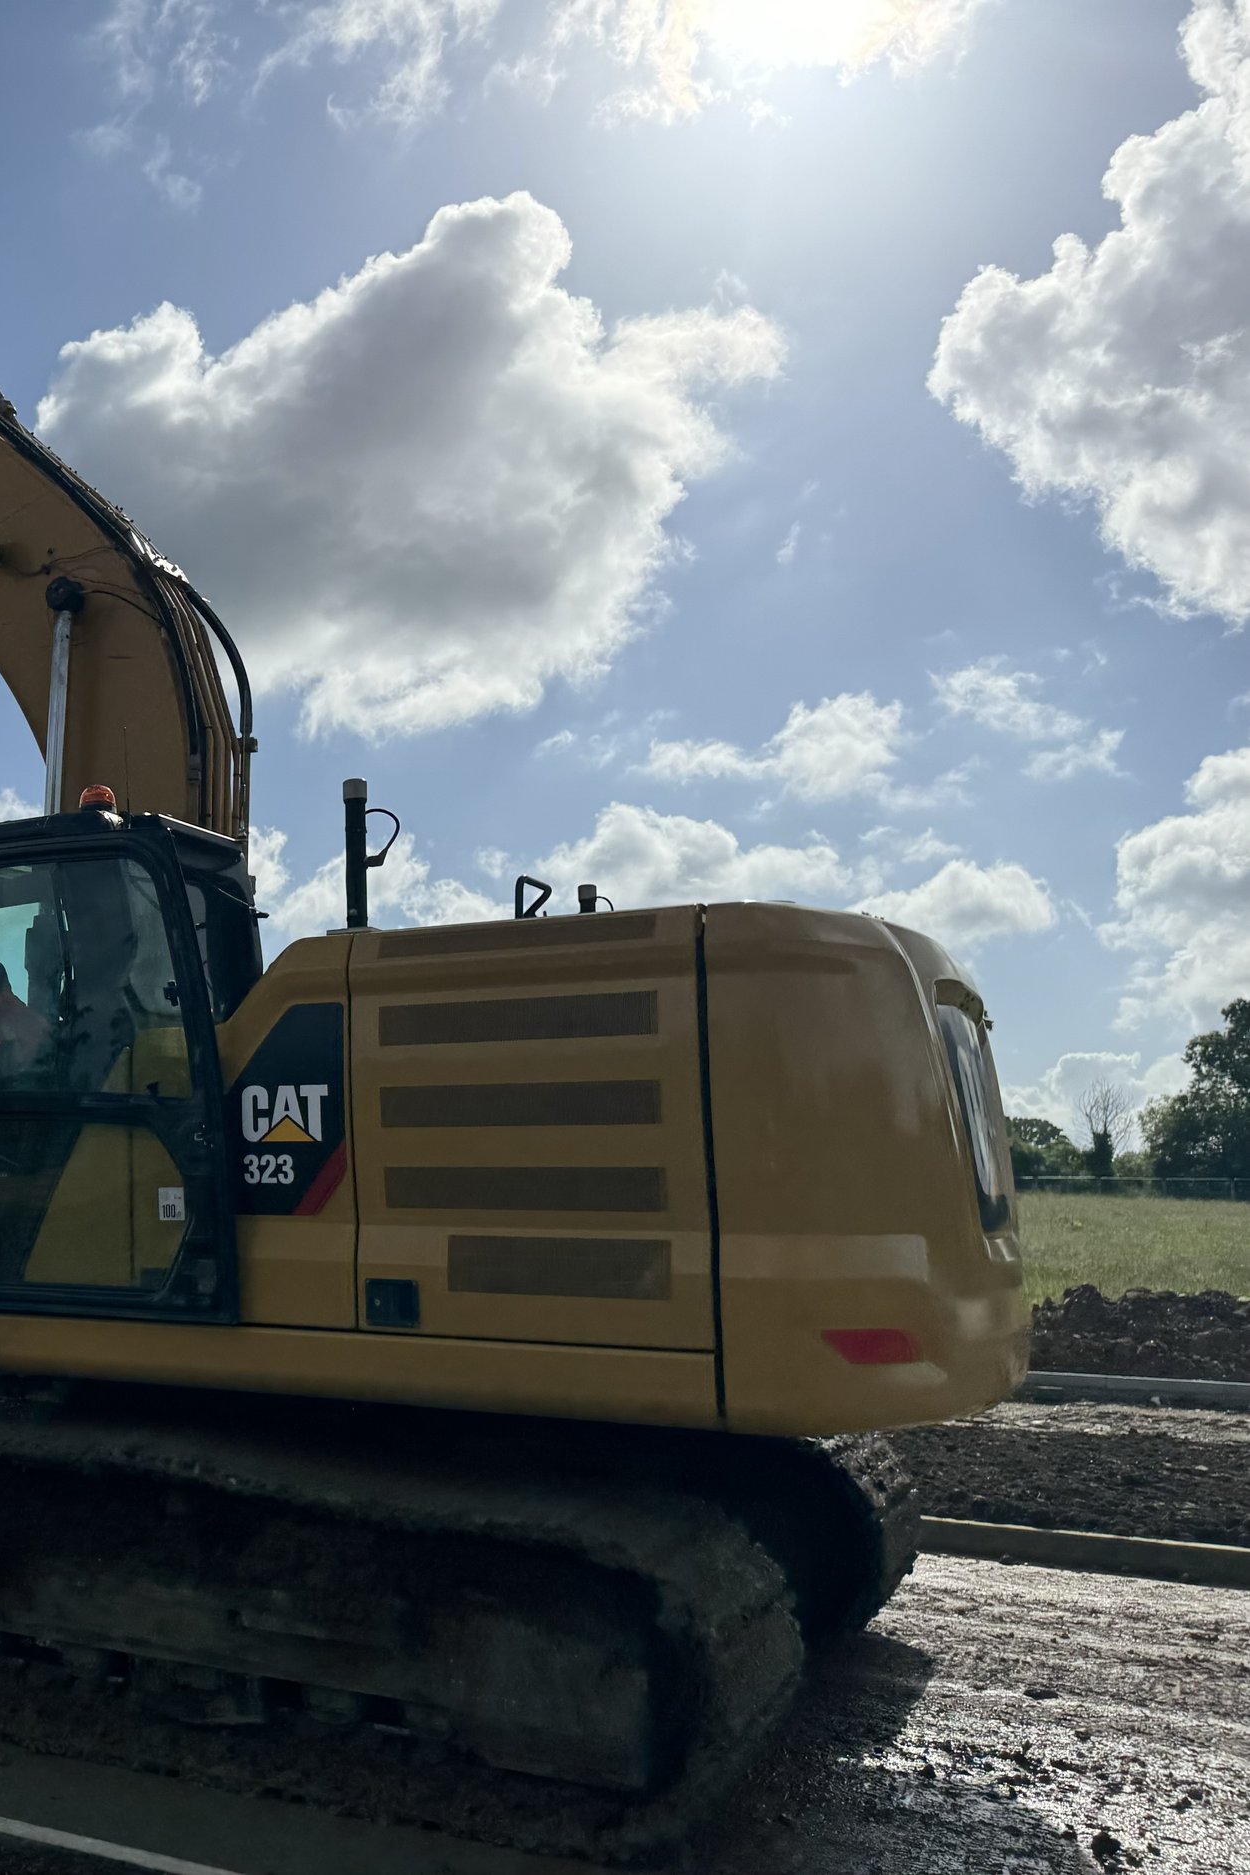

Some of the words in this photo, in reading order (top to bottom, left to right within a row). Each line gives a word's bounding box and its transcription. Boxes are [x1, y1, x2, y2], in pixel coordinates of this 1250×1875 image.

[241, 1084, 328, 1142] CAT
[243, 1154, 295, 1184] 323
[162, 1204, 176, 1218] 100
